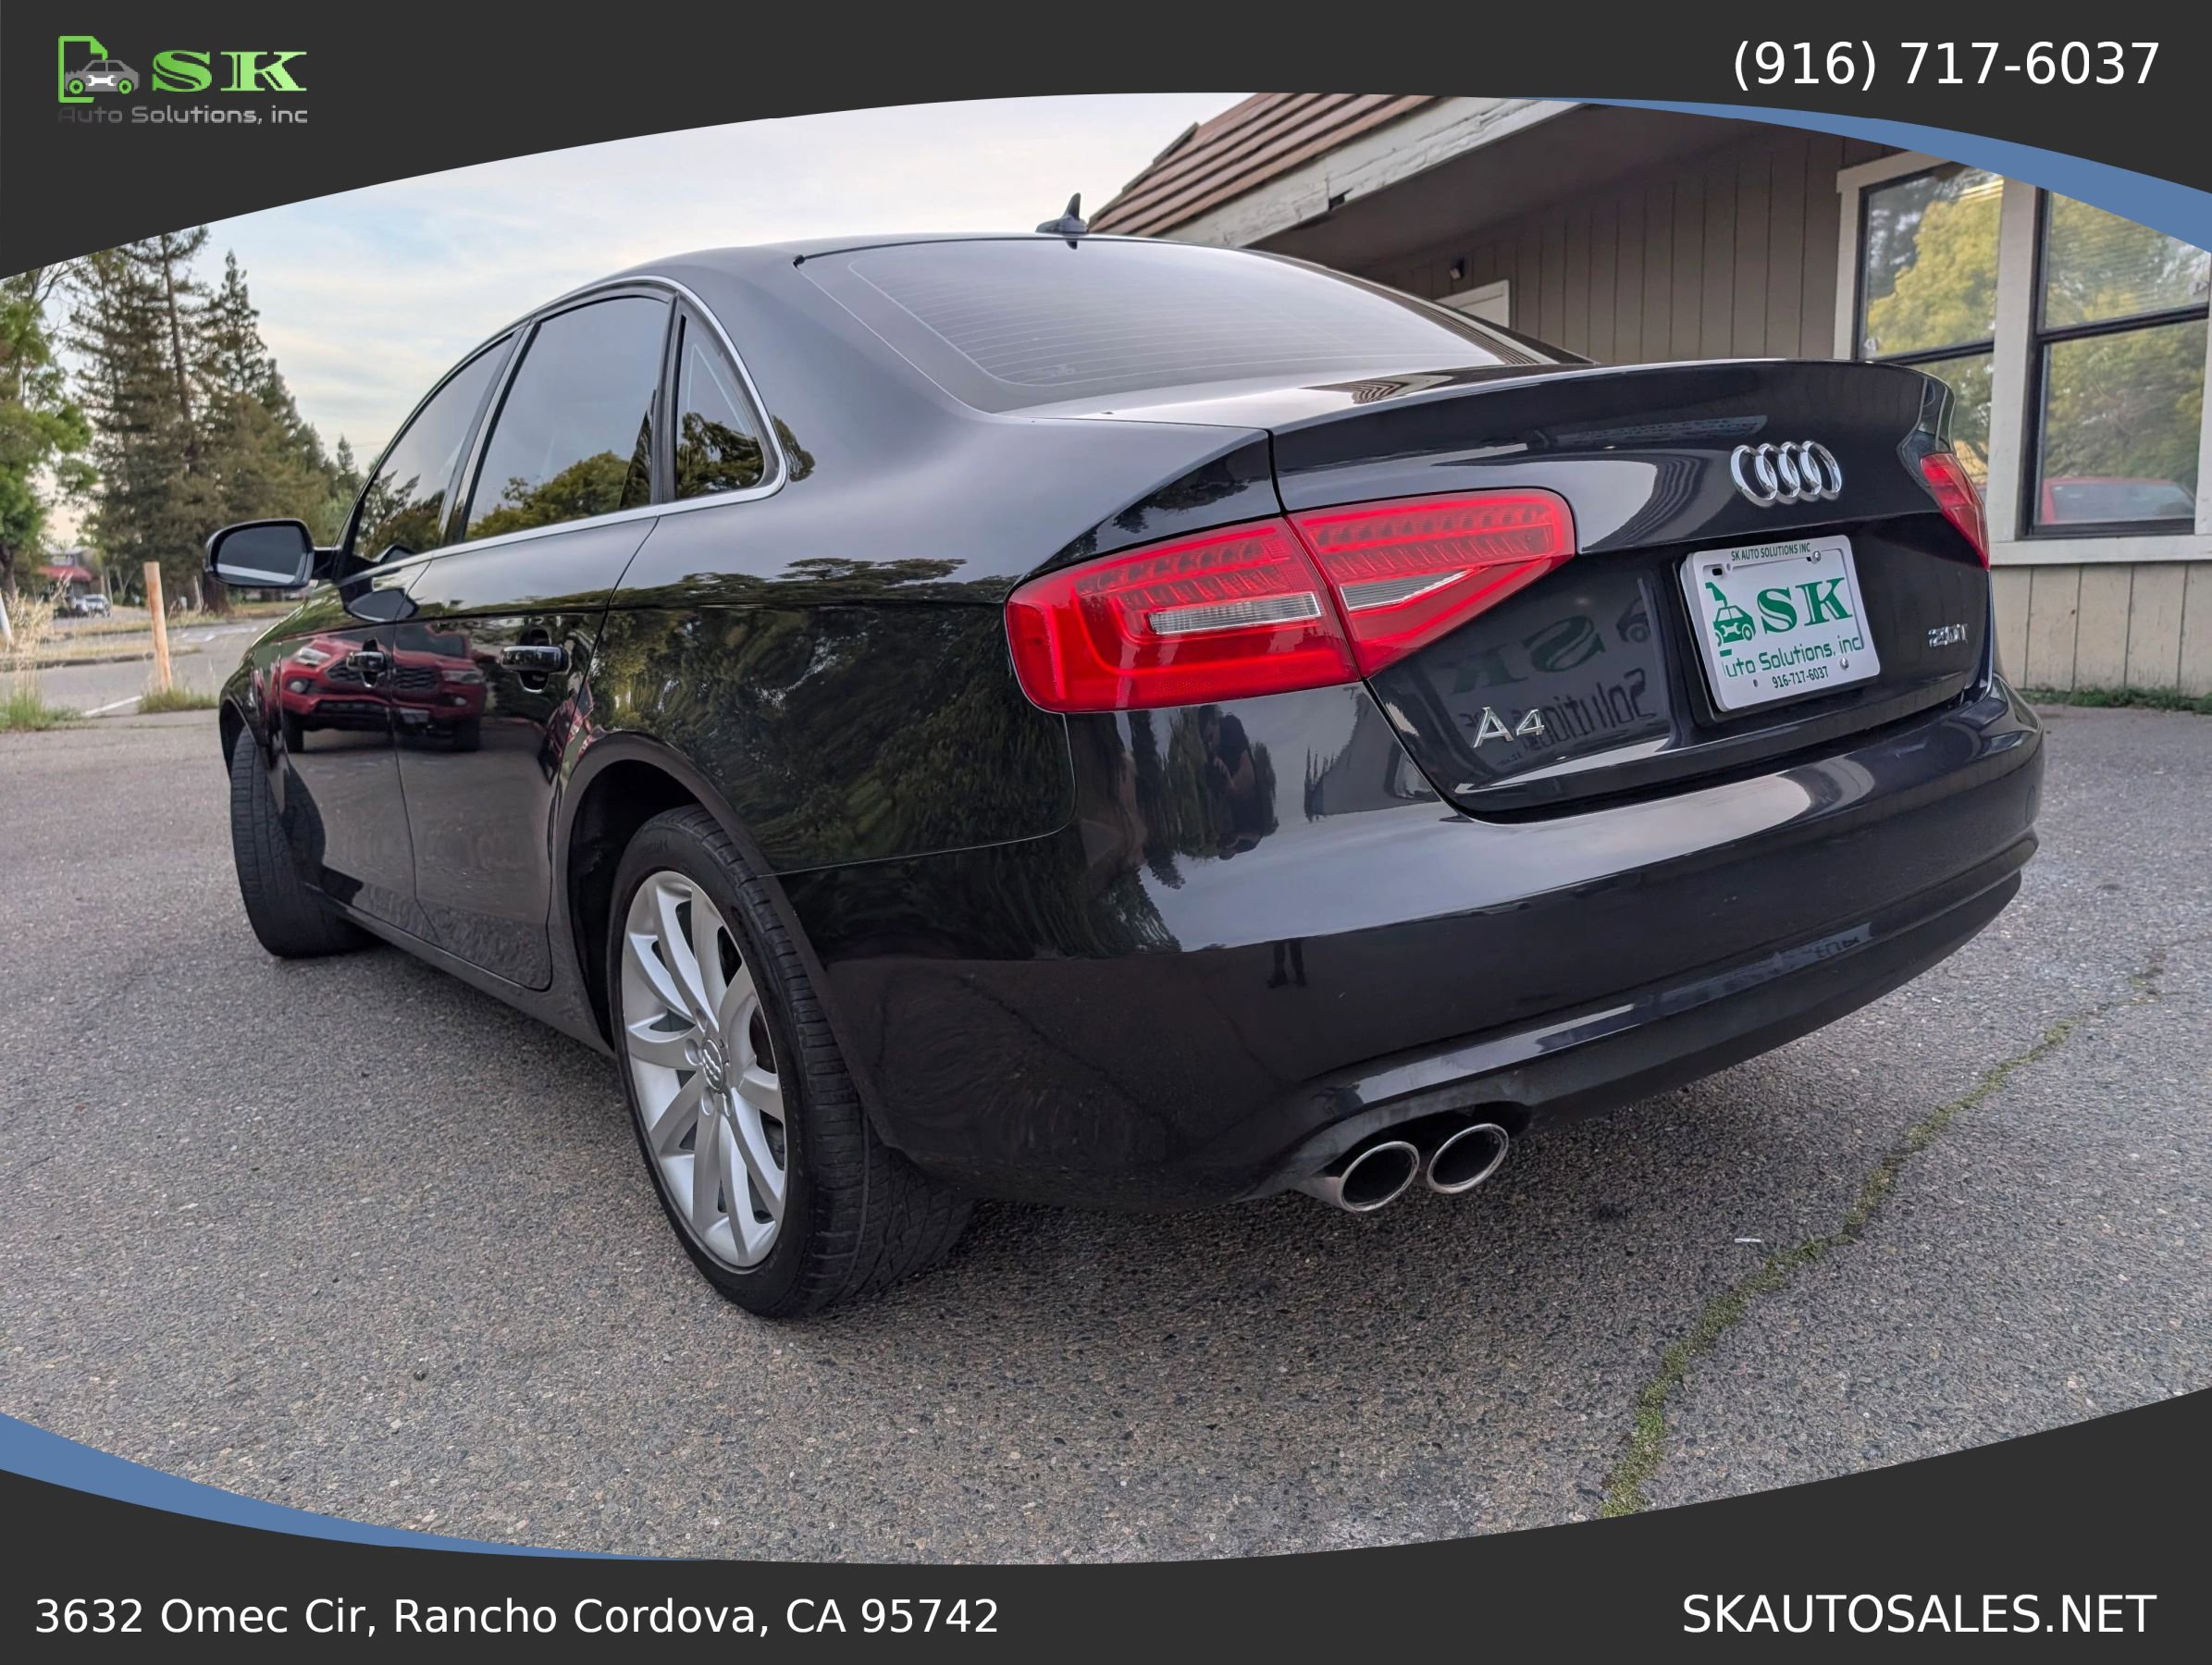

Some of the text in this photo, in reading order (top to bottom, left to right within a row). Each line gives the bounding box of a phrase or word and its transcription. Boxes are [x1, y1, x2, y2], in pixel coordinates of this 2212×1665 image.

[1731, 542, 1810, 561] SK AUTO SOLUTIONS INC
[1756, 576, 1853, 635] SK
[1722, 658, 1757, 678] uto
[1772, 666, 1830, 689] 916-717-6037
[1472, 706, 1546, 748] A4
